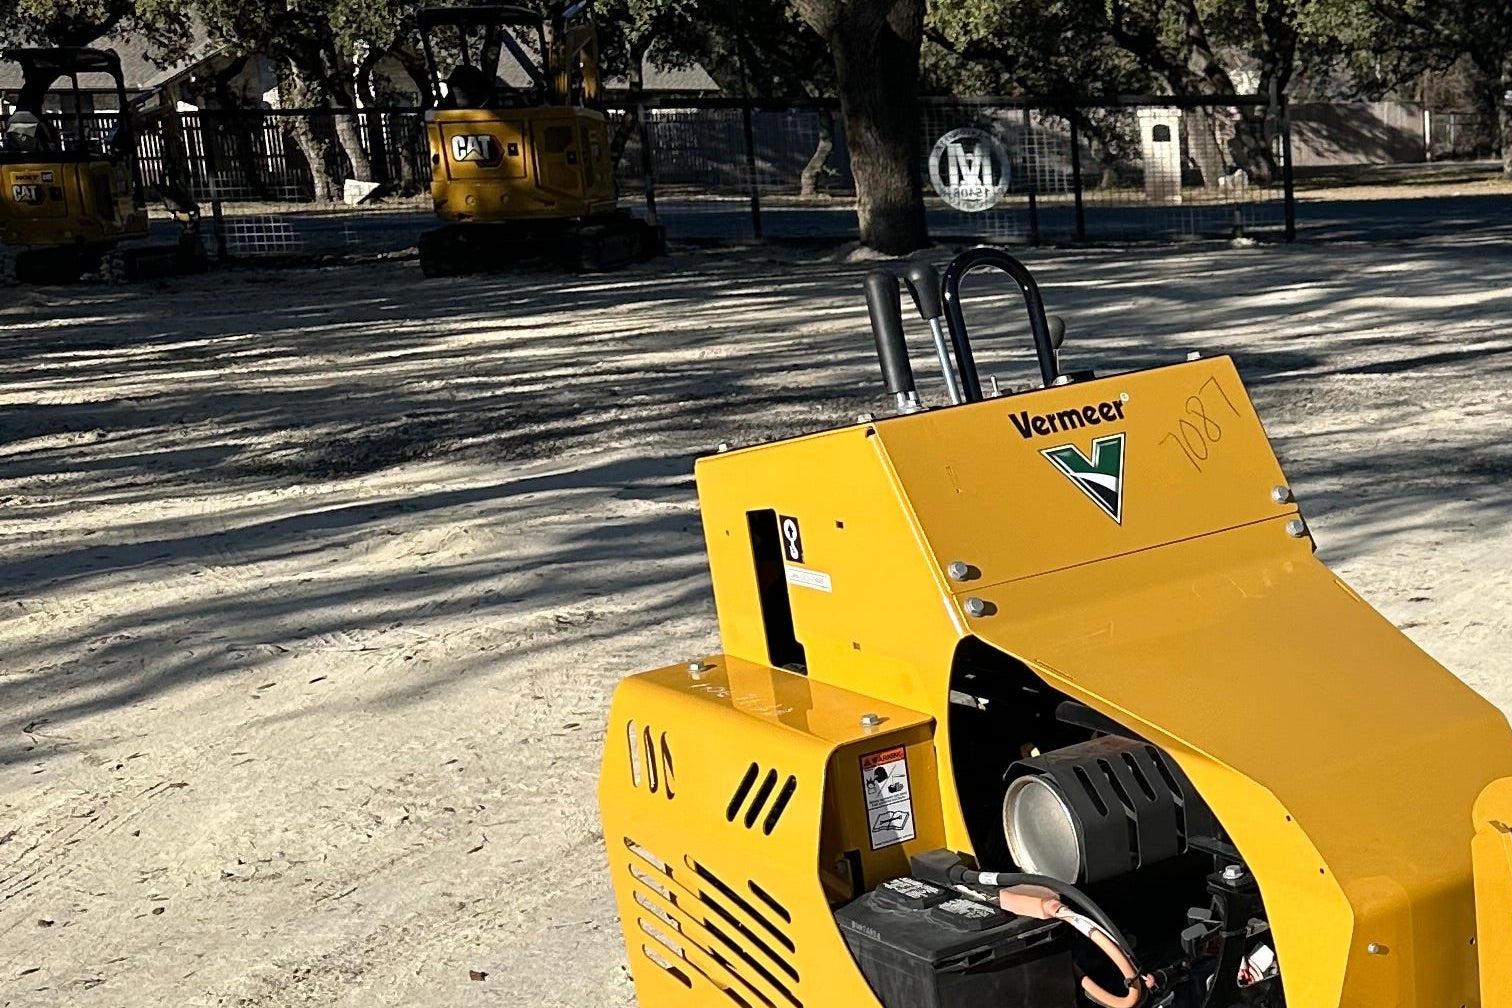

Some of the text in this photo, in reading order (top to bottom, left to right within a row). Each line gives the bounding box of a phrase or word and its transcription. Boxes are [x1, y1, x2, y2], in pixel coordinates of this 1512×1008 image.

[451, 135, 491, 161] CAT
[12, 185, 37, 202] CAT
[1008, 399, 1125, 439] Vermeer
[1158, 376, 1241, 473] 7087
